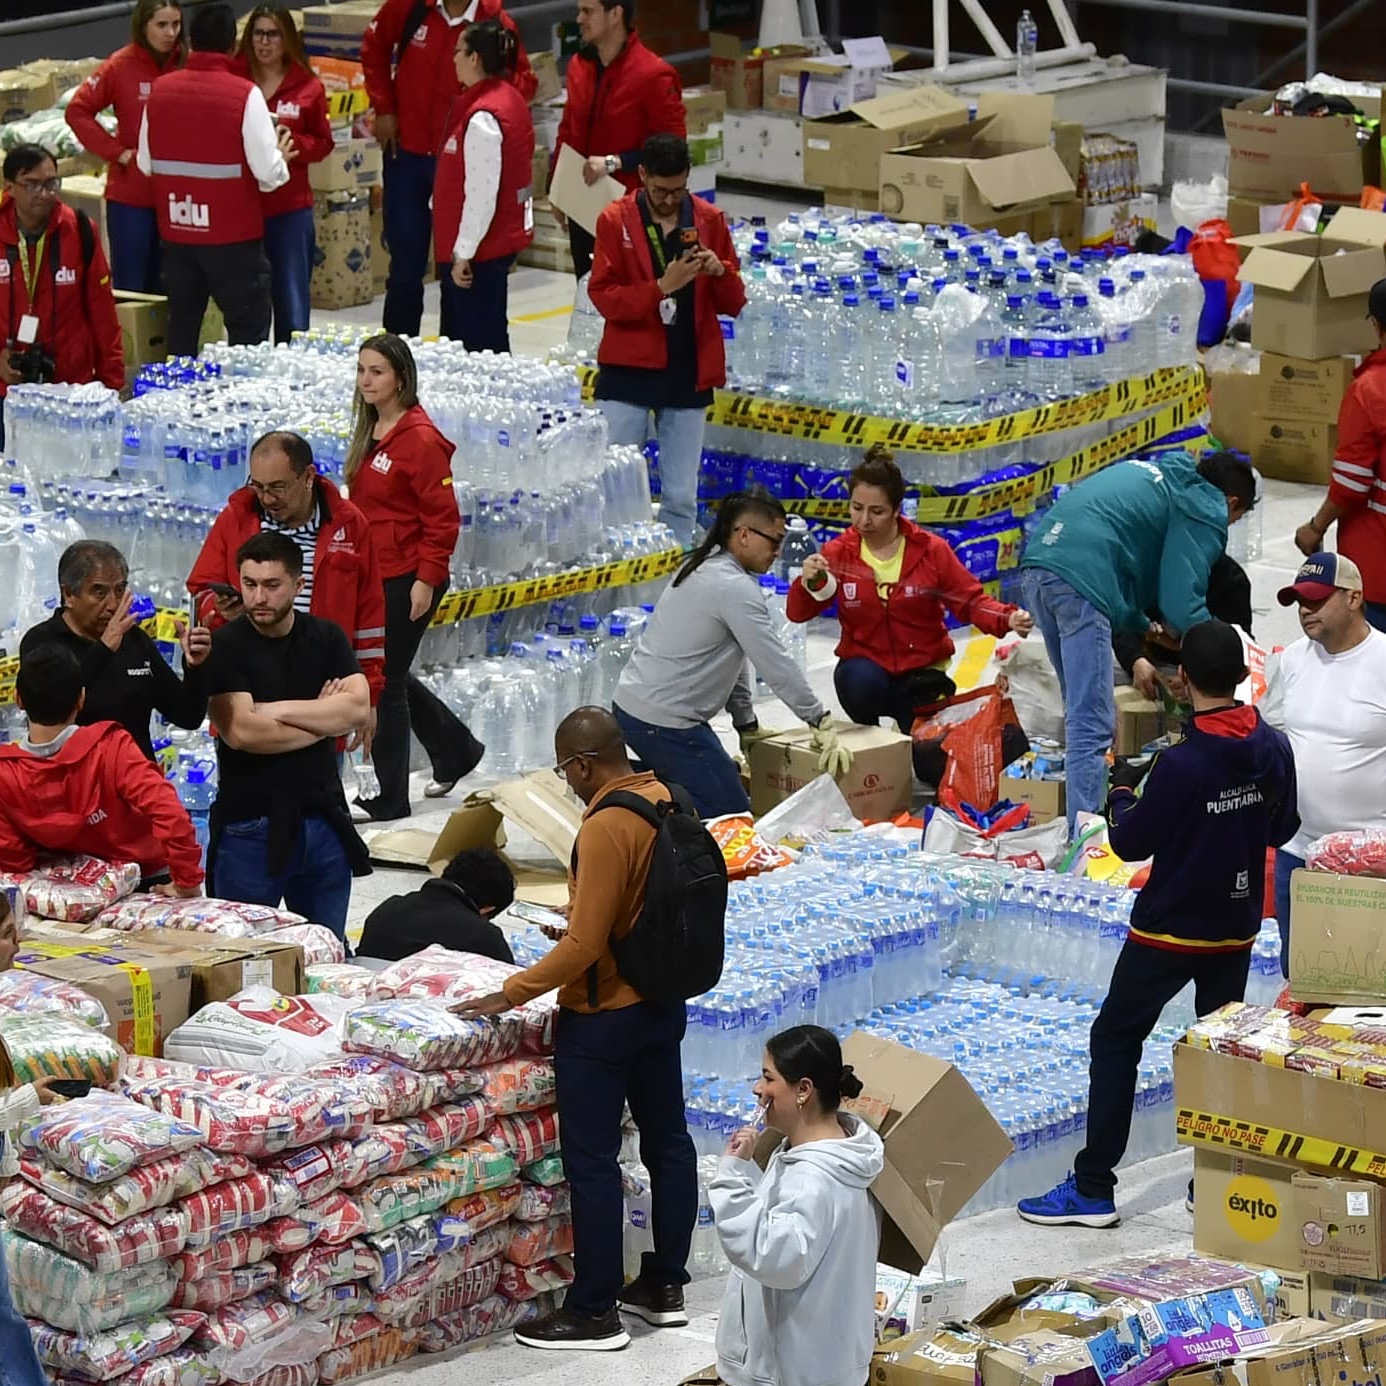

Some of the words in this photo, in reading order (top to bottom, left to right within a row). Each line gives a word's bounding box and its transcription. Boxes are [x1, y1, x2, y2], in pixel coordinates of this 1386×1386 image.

[168, 192, 210, 227] idu
[1176, 1116, 1221, 1136] PELIGRO
[1222, 1127, 1238, 1139] NO
[1239, 1129, 1266, 1147] PASE
[1099, 1345, 1139, 1374] angels
[1182, 1336, 1234, 1356] TOALLITAS
